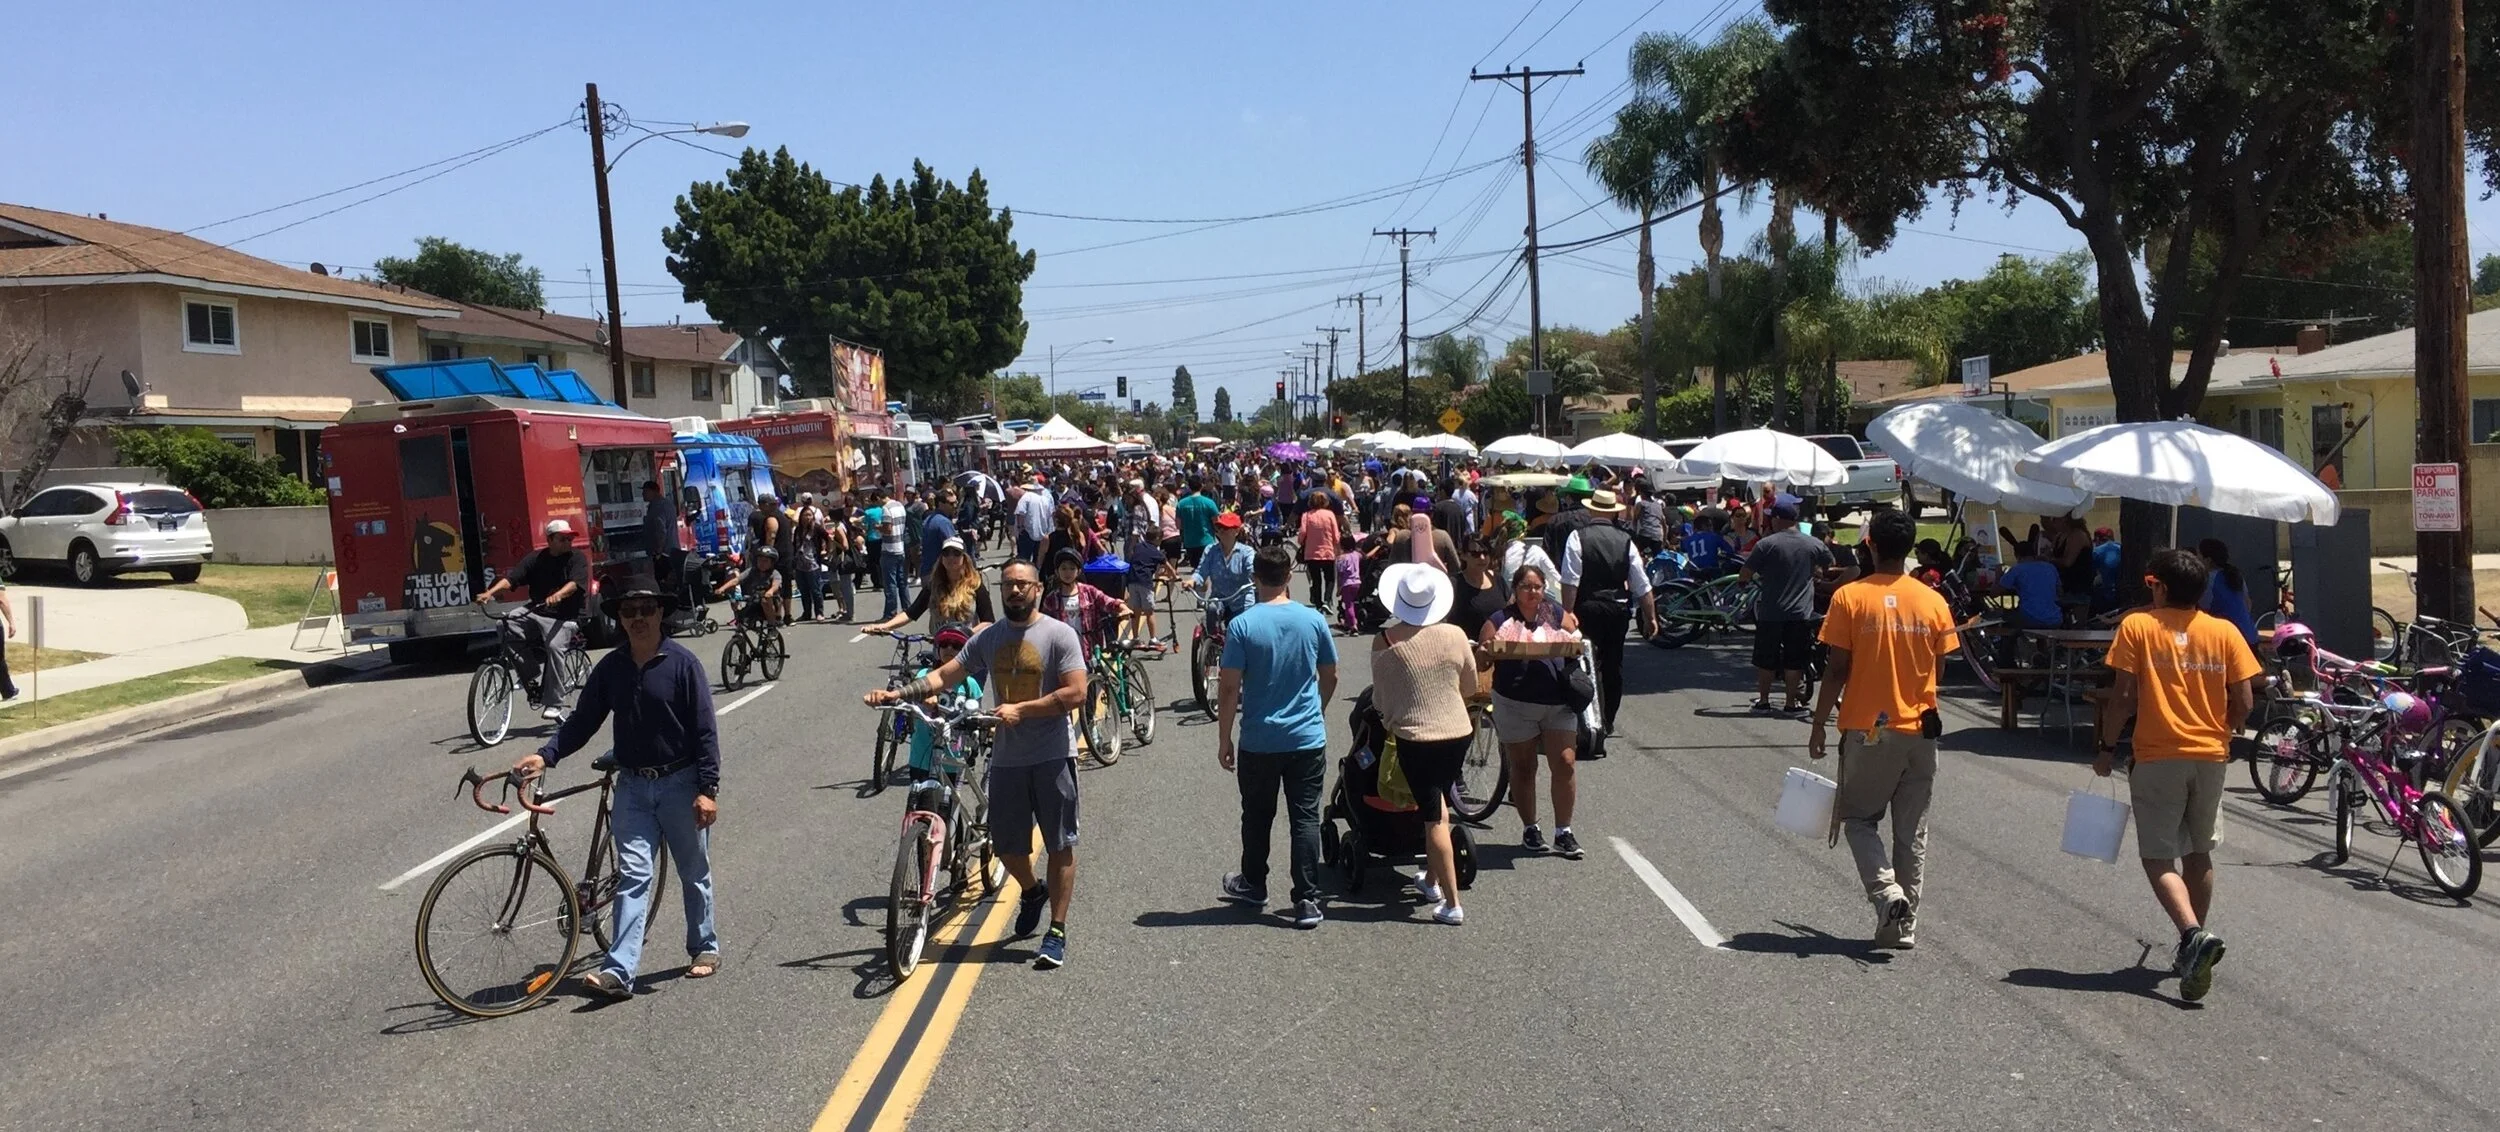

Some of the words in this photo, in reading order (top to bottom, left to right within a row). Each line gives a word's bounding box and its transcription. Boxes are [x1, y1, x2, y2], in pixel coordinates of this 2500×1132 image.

[2416, 466, 2454, 475] TEMPORARY
[2416, 475, 2434, 487] NO
[2416, 488, 2455, 497] PARKING
[1690, 539, 1707, 558] 11
